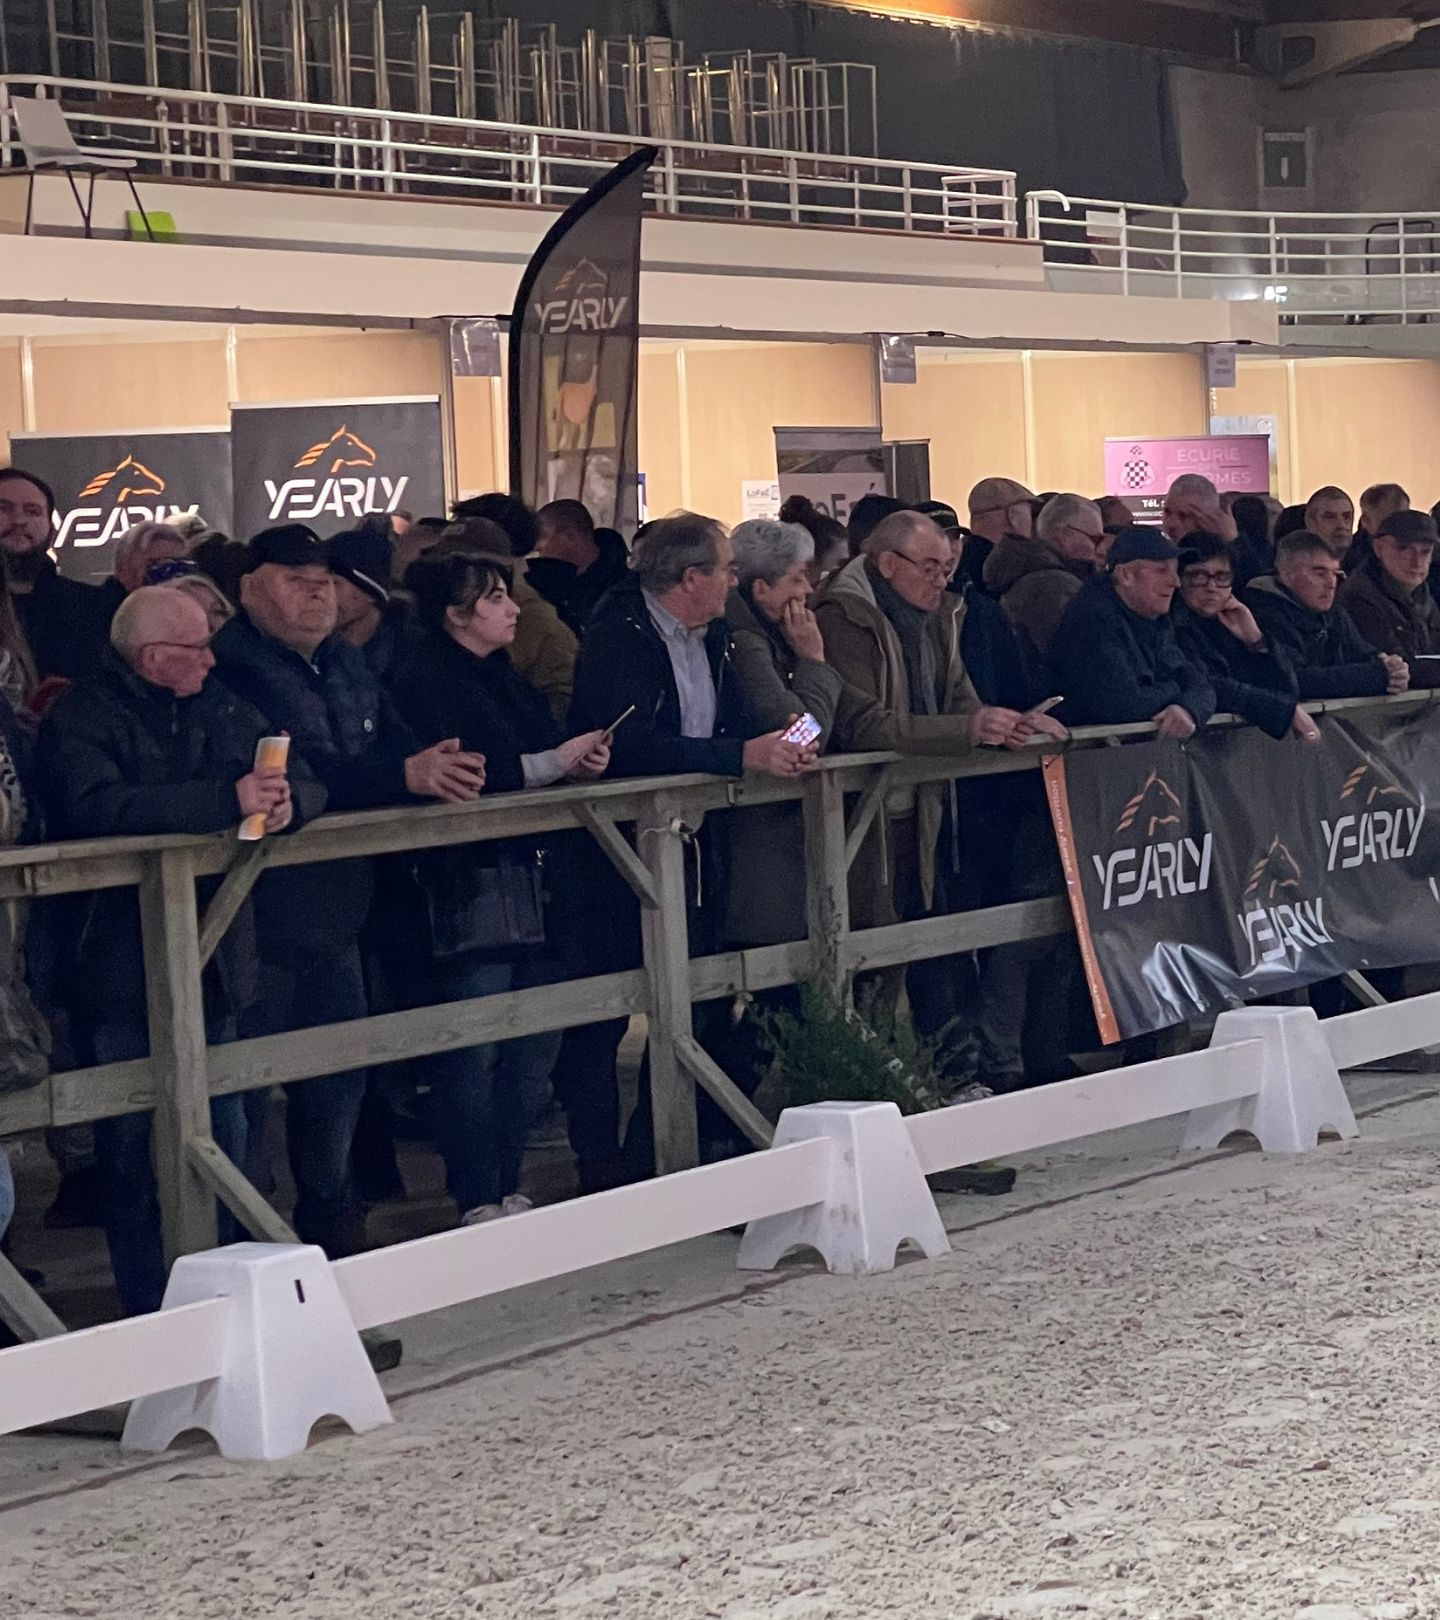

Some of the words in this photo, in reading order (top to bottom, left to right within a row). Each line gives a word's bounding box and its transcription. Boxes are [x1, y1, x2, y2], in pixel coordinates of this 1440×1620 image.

[534, 296, 628, 334] YEARLY
[264, 476, 409, 520] YEARLY
[1092, 832, 1213, 910] YEARLY
[1320, 805, 1426, 872] YEARLY
[1237, 897, 1335, 967] YEARLY
